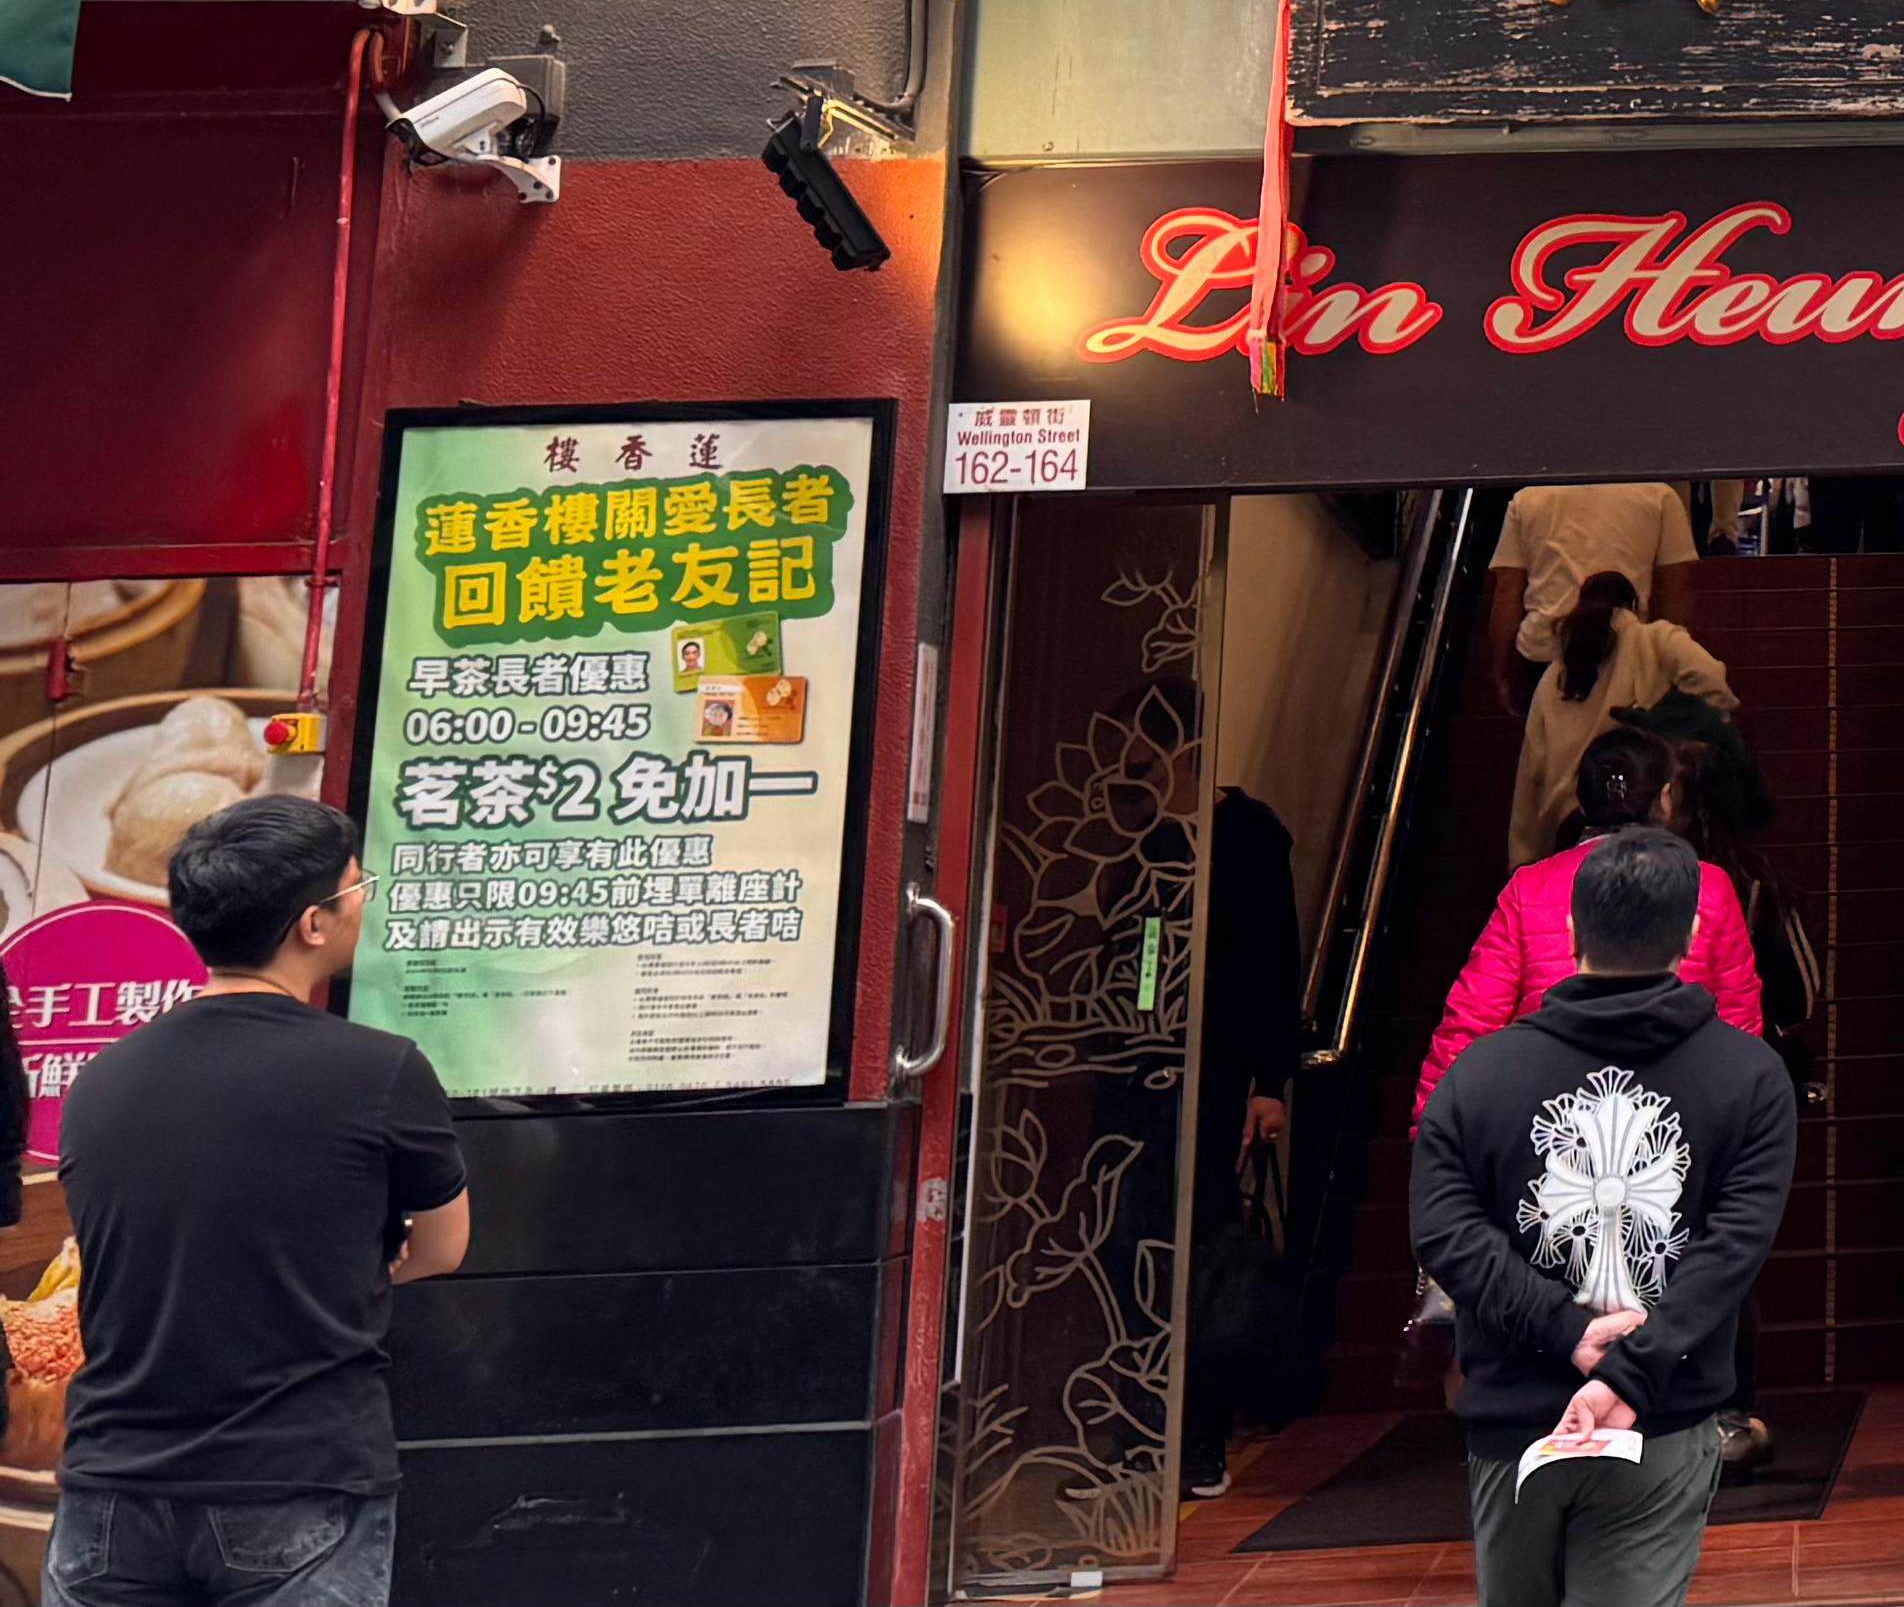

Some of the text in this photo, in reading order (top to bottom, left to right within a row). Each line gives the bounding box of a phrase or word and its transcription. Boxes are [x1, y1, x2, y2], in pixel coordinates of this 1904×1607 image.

[1079, 207, 1443, 363] Lin
[958, 429, 1080, 447] Wellington Street
[975, 407, 1065, 426] 威靈頓街
[955, 449, 1078, 484] 162-164
[424, 473, 836, 556] 蓮香樓關愛長者
[443, 535, 816, 629] 回饋老友記
[408, 652, 650, 698] 早茶長者優惠
[404, 709, 513, 745] 06:00
[539, 705, 650, 741] 09:45
[616, 754, 817, 824] 免加一
[392, 834, 713, 875] 同行者亦可享有此優惠
[388, 870, 802, 913] 優惠只限09:45前埋單離座計
[384, 908, 801, 952] 及請出示有效樂悠咭或長者咭
